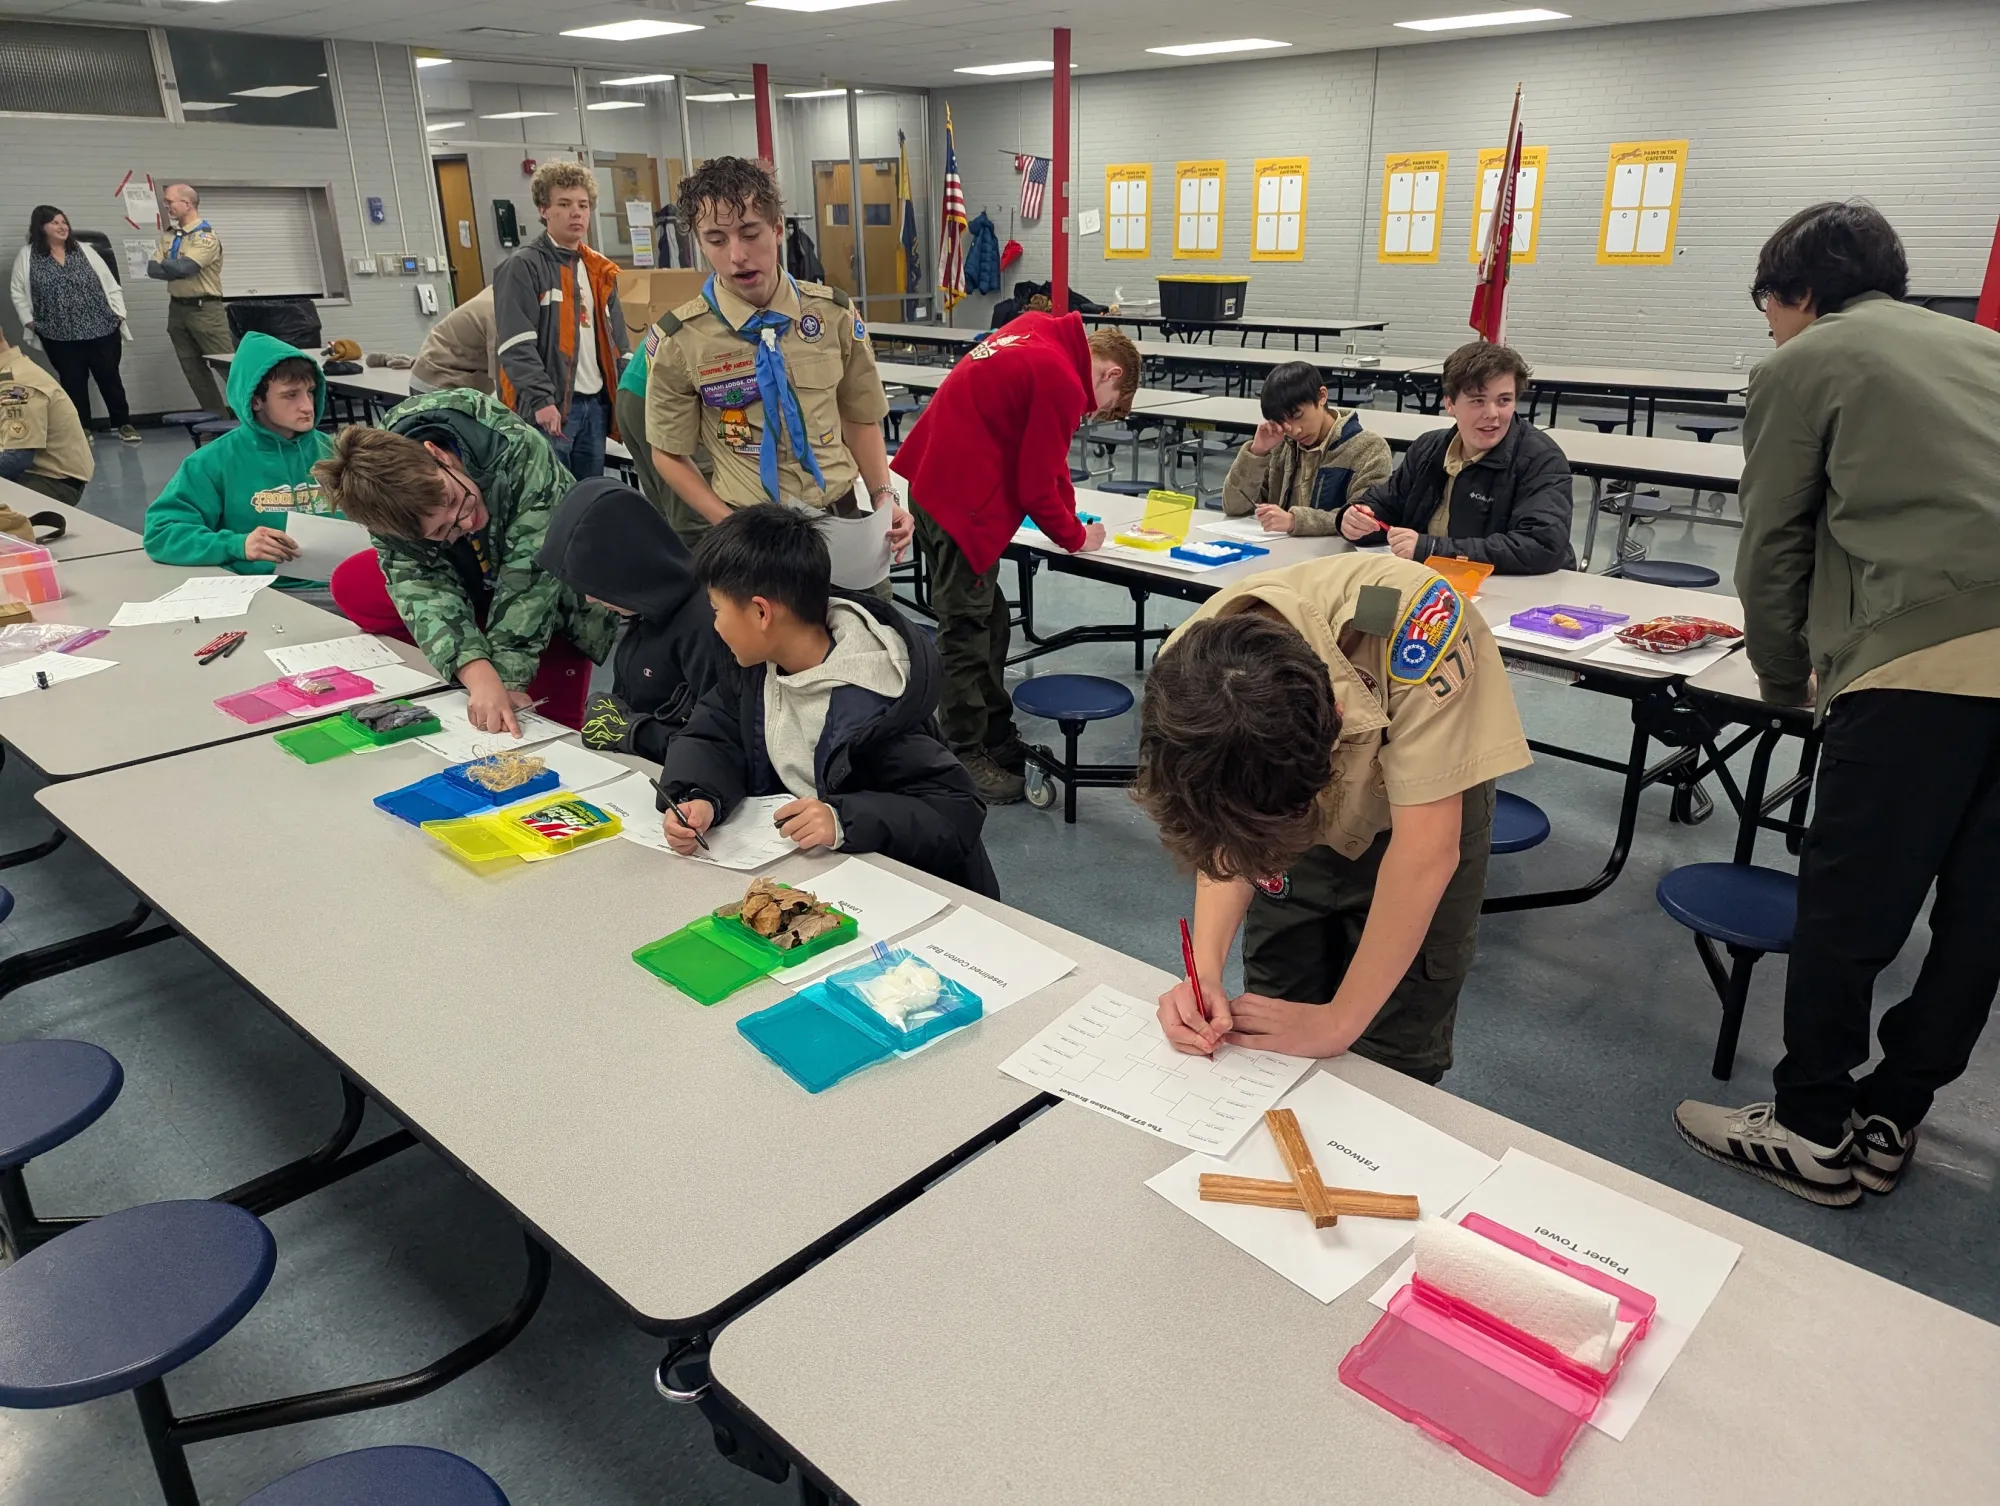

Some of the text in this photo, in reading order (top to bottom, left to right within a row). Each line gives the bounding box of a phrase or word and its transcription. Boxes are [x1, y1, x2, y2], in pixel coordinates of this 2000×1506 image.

[700, 360, 753, 376] SCOUTING AMERICA
[704, 384, 725, 393] UNAMI
[7, 408, 22, 418] 577
[1391, 629, 1407, 662] CRADLE
[1416, 584, 1439, 611] LIBERTY
[1428, 614, 1459, 662] PENNSYLVANIA
[838, 900, 864, 914] Leaves
[926, 943, 1008, 989] Vaselined Cotton Ball
[1058, 1087, 1089, 1103] Bracket
[1130, 1117, 1147, 1126] 577
[1147, 1122, 1163, 1133] The
[1866, 1134, 1889, 1148] adidas
[1326, 1139, 1381, 1172] Fatwood
[1534, 1225, 1630, 1276] Paper Towel
